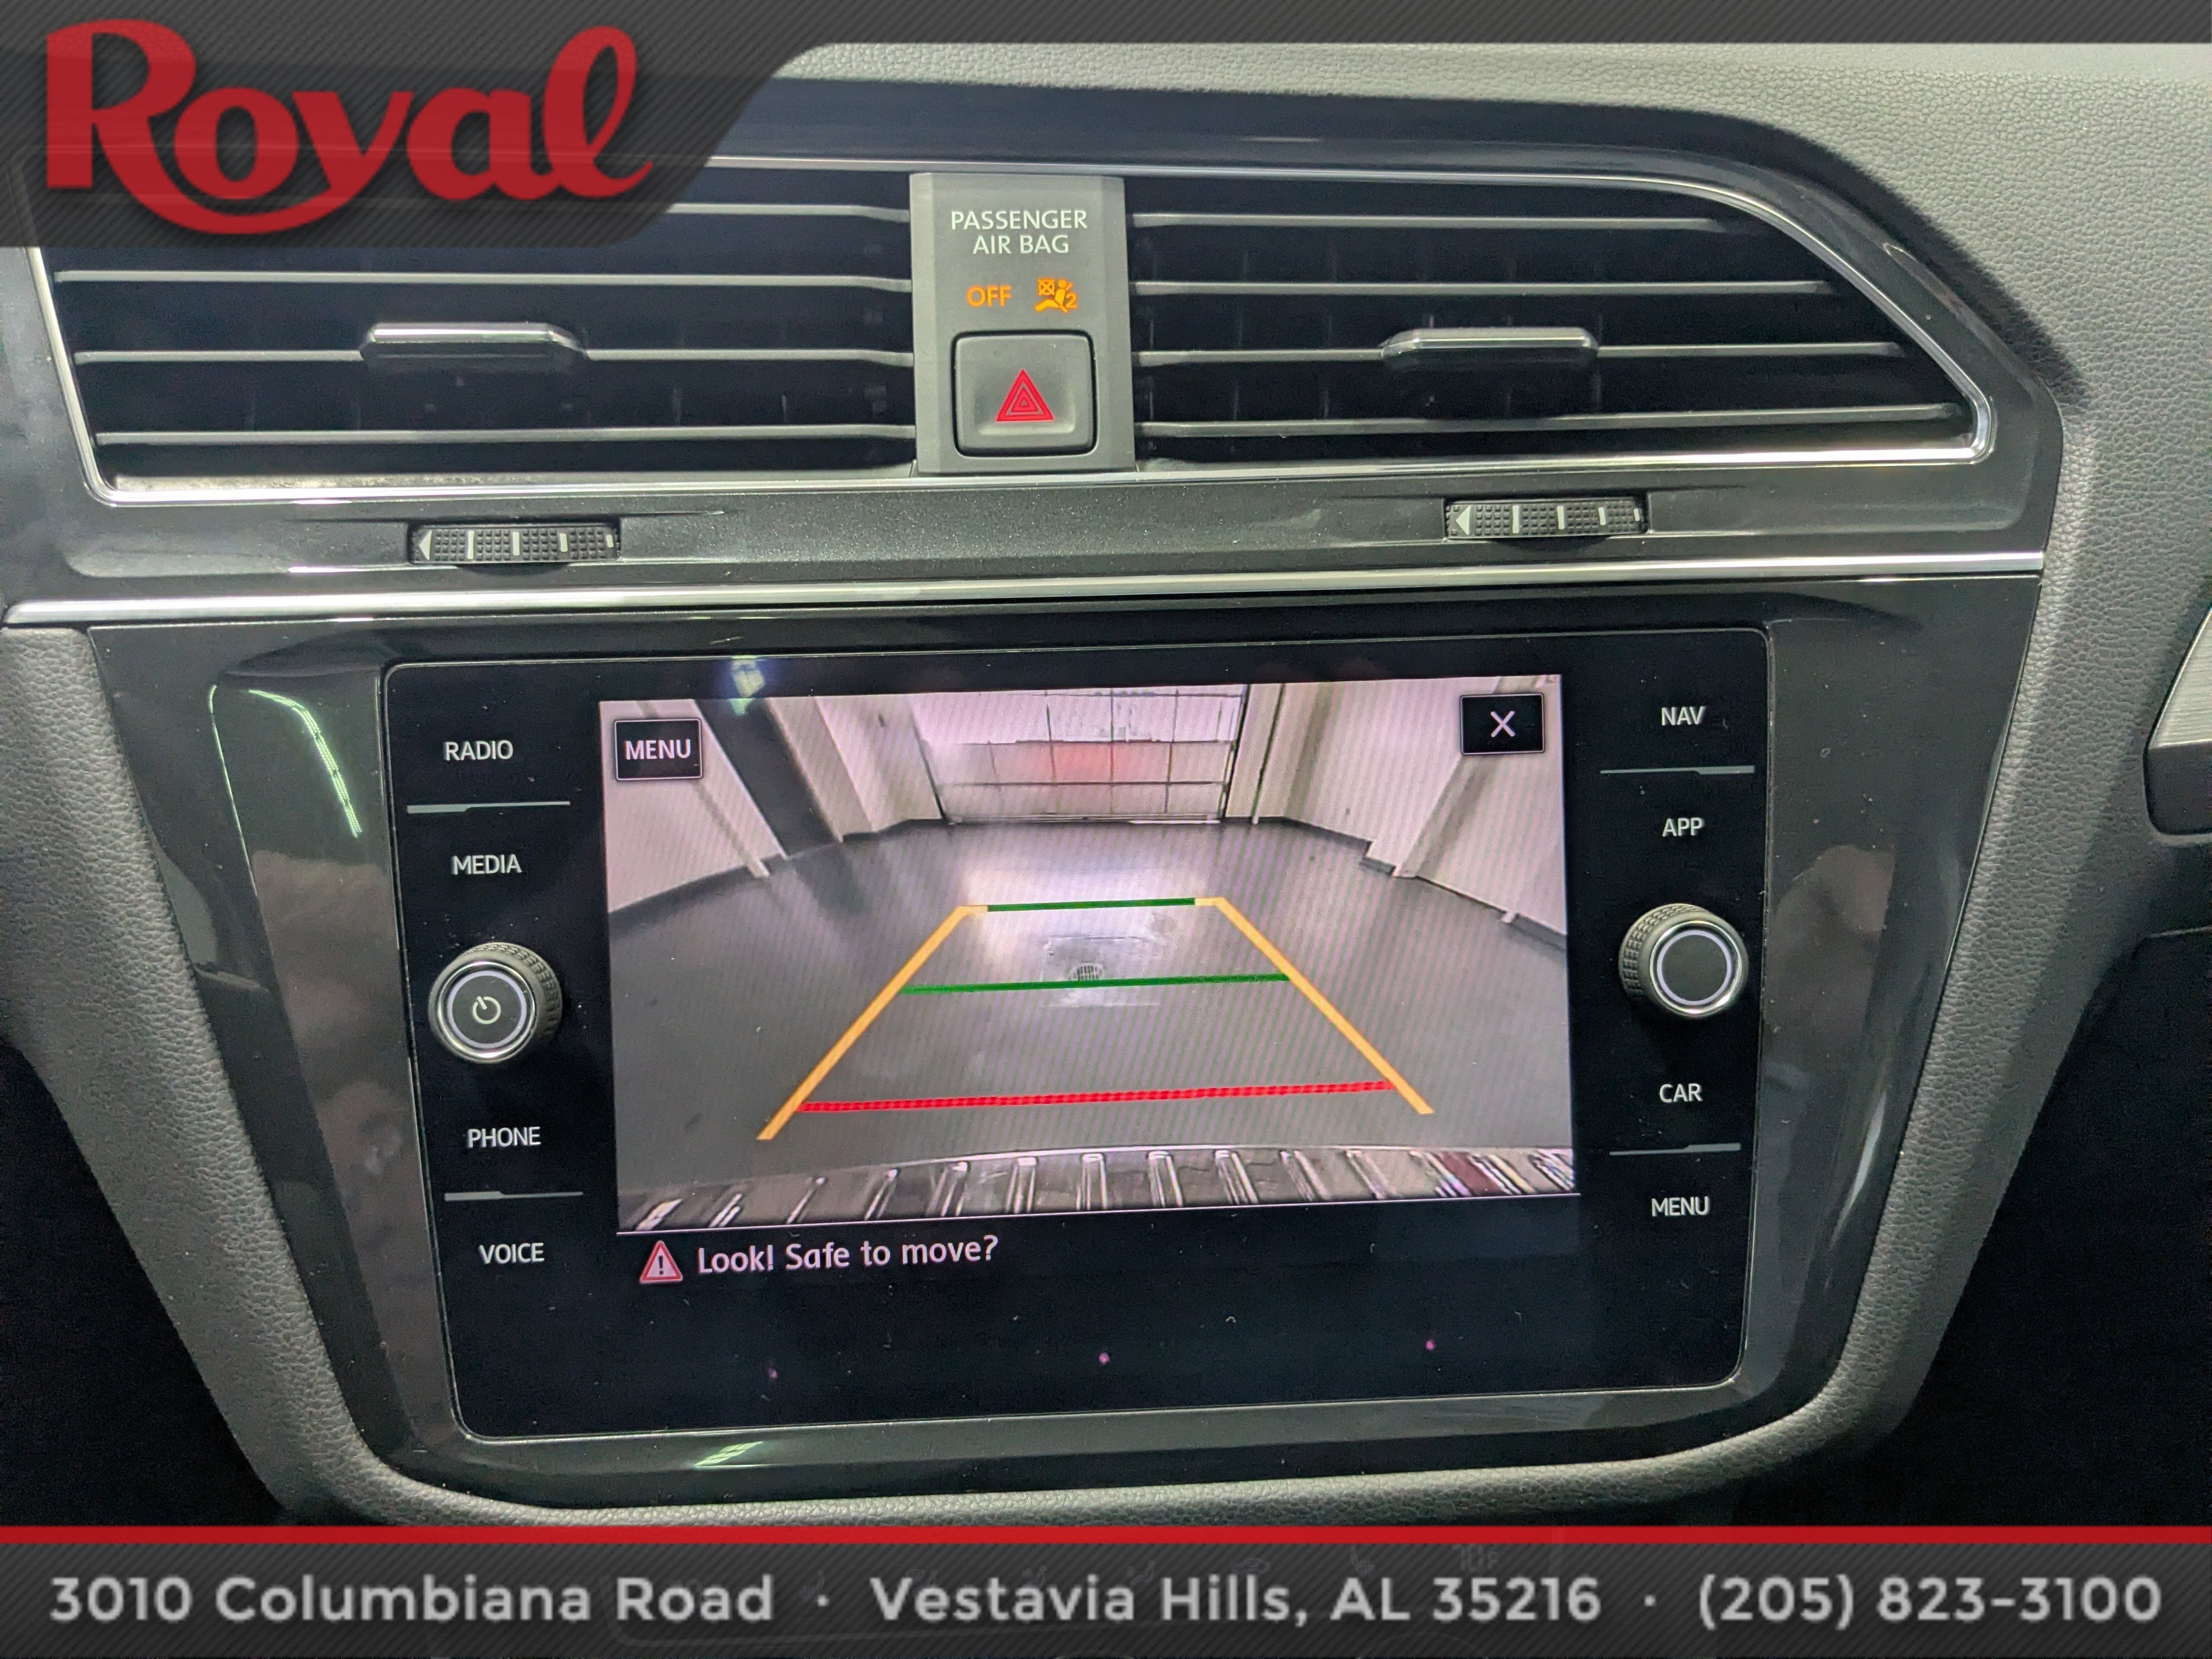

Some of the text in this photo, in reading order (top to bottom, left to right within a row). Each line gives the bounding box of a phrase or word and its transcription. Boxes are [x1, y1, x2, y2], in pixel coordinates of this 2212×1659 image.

[951, 210, 1088, 230] PASSENGER
[973, 234, 1069, 255] AIR BAG
[966, 285, 1012, 307] OFF
[1661, 706, 1706, 726] NAV
[444, 740, 514, 761] RADIO
[625, 738, 692, 760] MENU
[1662, 817, 1705, 837] APP
[451, 854, 523, 876] MEDIA
[1658, 1082, 1704, 1104] CAR
[467, 1126, 541, 1149] PHONE
[1651, 1195, 1711, 1217] MENU
[479, 1242, 545, 1265] VOICE
[698, 1234, 999, 1275] Look! Safe to move?
